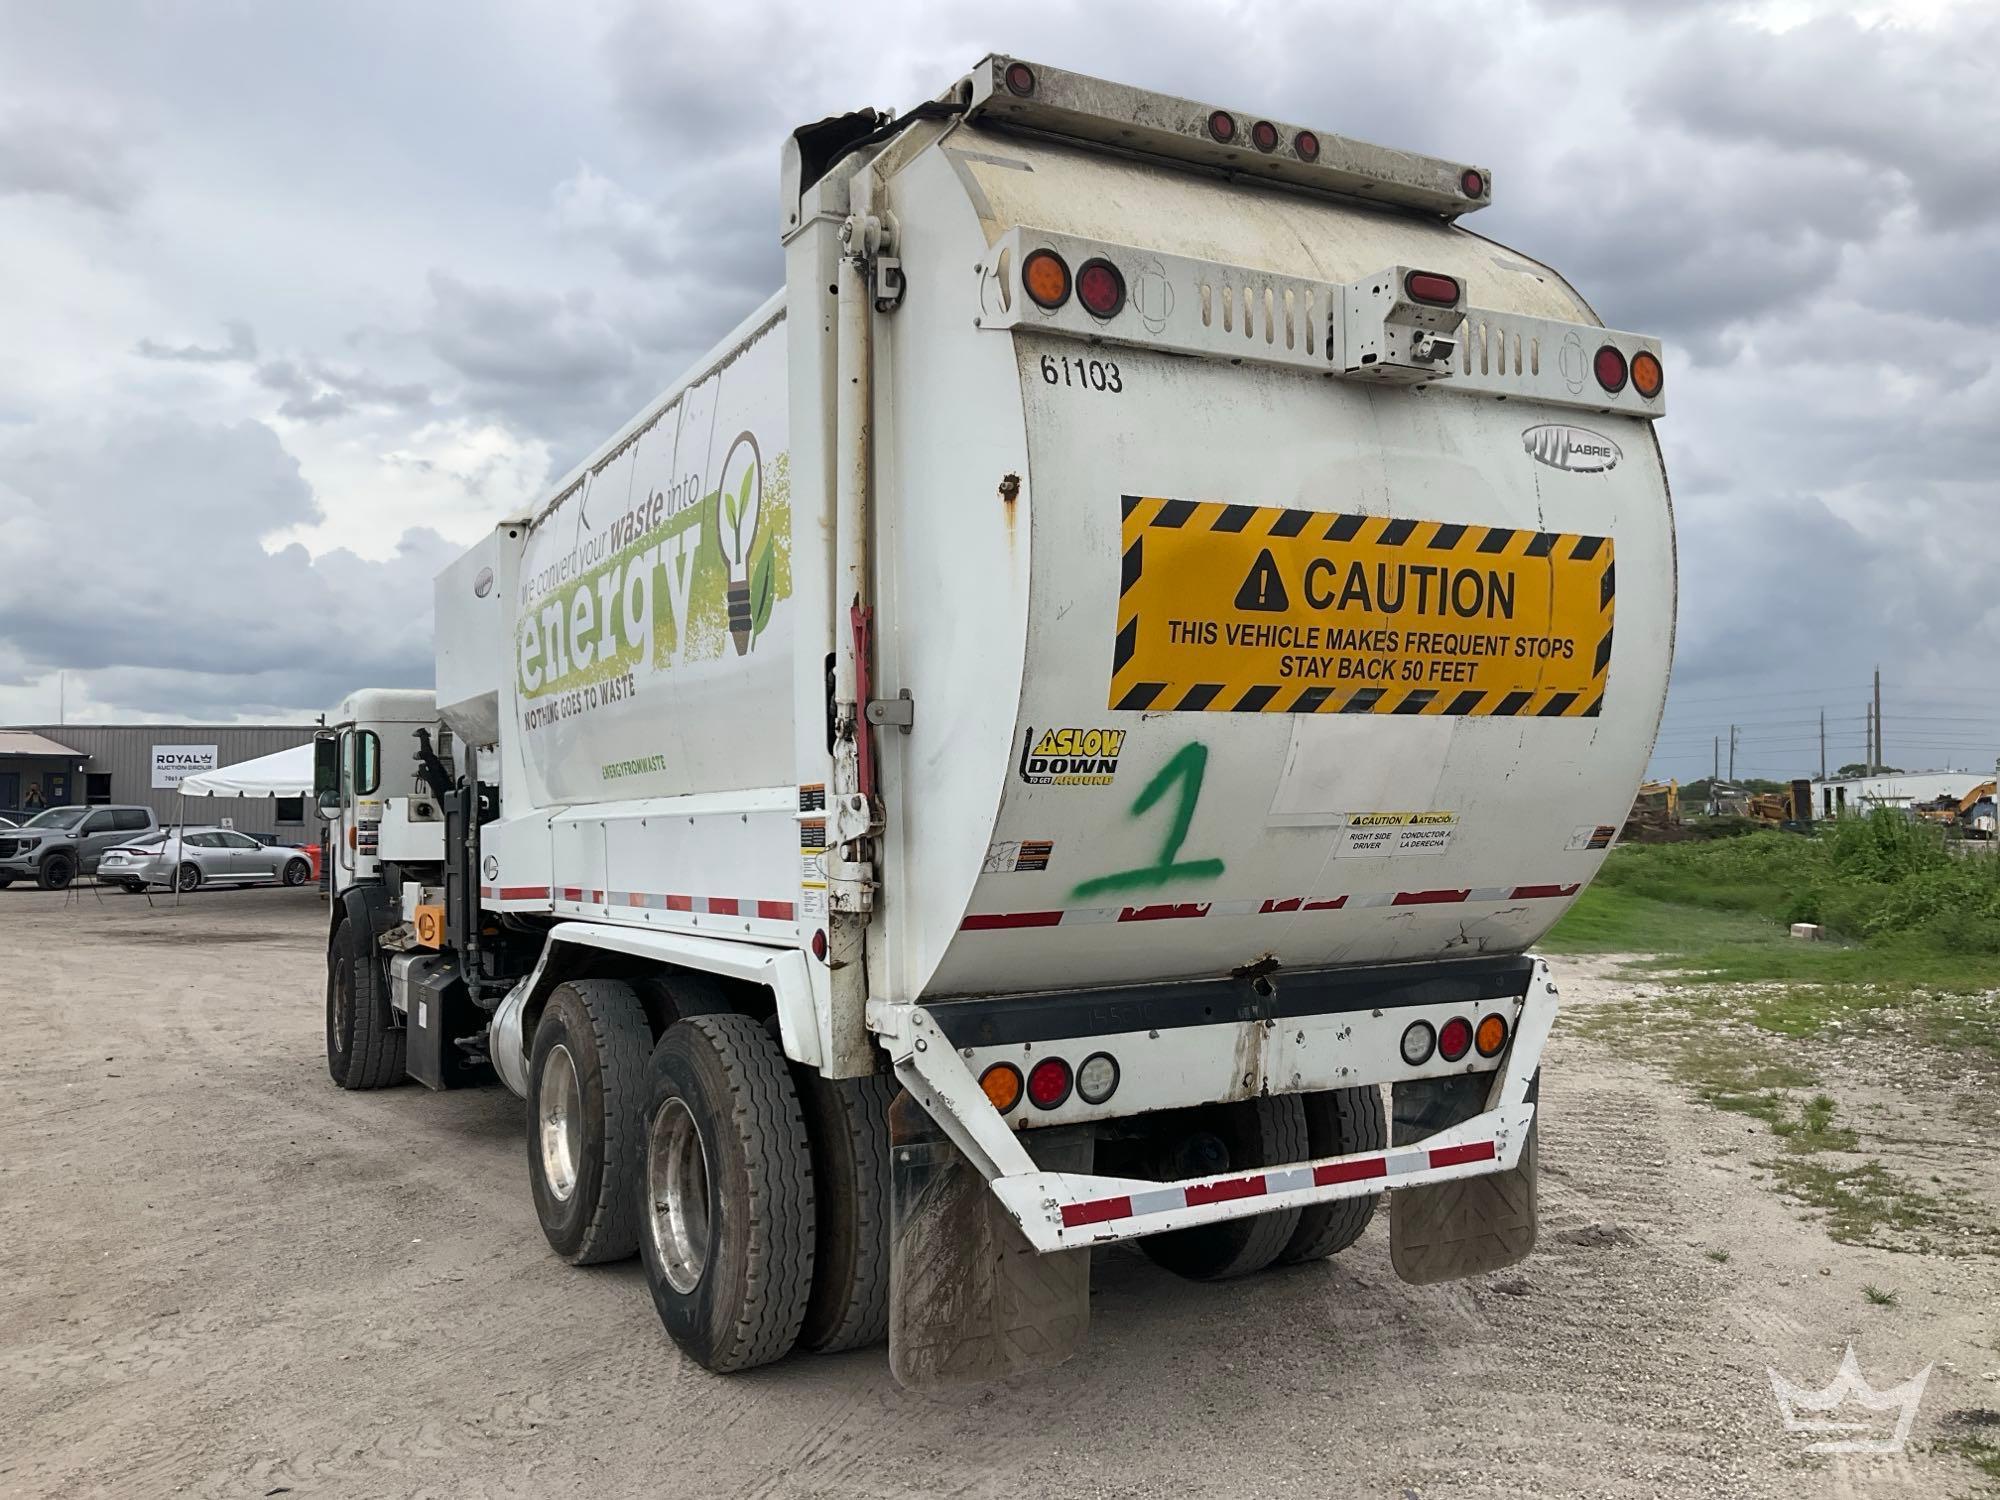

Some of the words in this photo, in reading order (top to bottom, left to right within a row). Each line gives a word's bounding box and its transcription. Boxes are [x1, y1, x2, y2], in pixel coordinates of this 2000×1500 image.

[1040, 354, 1123, 393] 61103
[1569, 442, 1611, 458] LABRIE
[536, 546, 578, 596] convert
[578, 529, 607, 580] your
[610, 488, 664, 554] waste
[667, 472, 700, 517] into
[1303, 557, 1516, 620] CAUTION
[520, 522, 702, 693] energy
[1168, 620, 1218, 645] THIS
[1226, 623, 1321, 649] VEHICLE
[1326, 628, 1399, 653] MAKES
[1404, 632, 1511, 658] FREQUENT
[1514, 636, 1575, 660] STOPS
[1279, 655, 1334, 678] STAY
[1337, 657, 1397, 681] BACK
[1401, 660, 1424, 682] 50
[1428, 661, 1479, 683] FEET
[524, 700, 559, 731] NOTHING
[561, 692, 582, 720] GOES
[583, 688, 597, 711] TO
[599, 673, 636, 706] WASTE
[1055, 728, 1127, 758] SLOW
[157, 755, 200, 763] ROYAL
[601, 754, 667, 780] ENERGYFROMWASTE
[1028, 758, 1119, 774] DOWN
[1052, 776, 1115, 786] AROUND
[1072, 741, 1225, 895] 1
[1361, 816, 1403, 826] CAUTION
[1349, 833, 1373, 841] RIGHT
[1374, 832, 1392, 840] SIDE
[1352, 842, 1382, 850] DRIVER
[1401, 831, 1445, 839] CONDUCTOR
[1410, 840, 1445, 848] DERECHA
